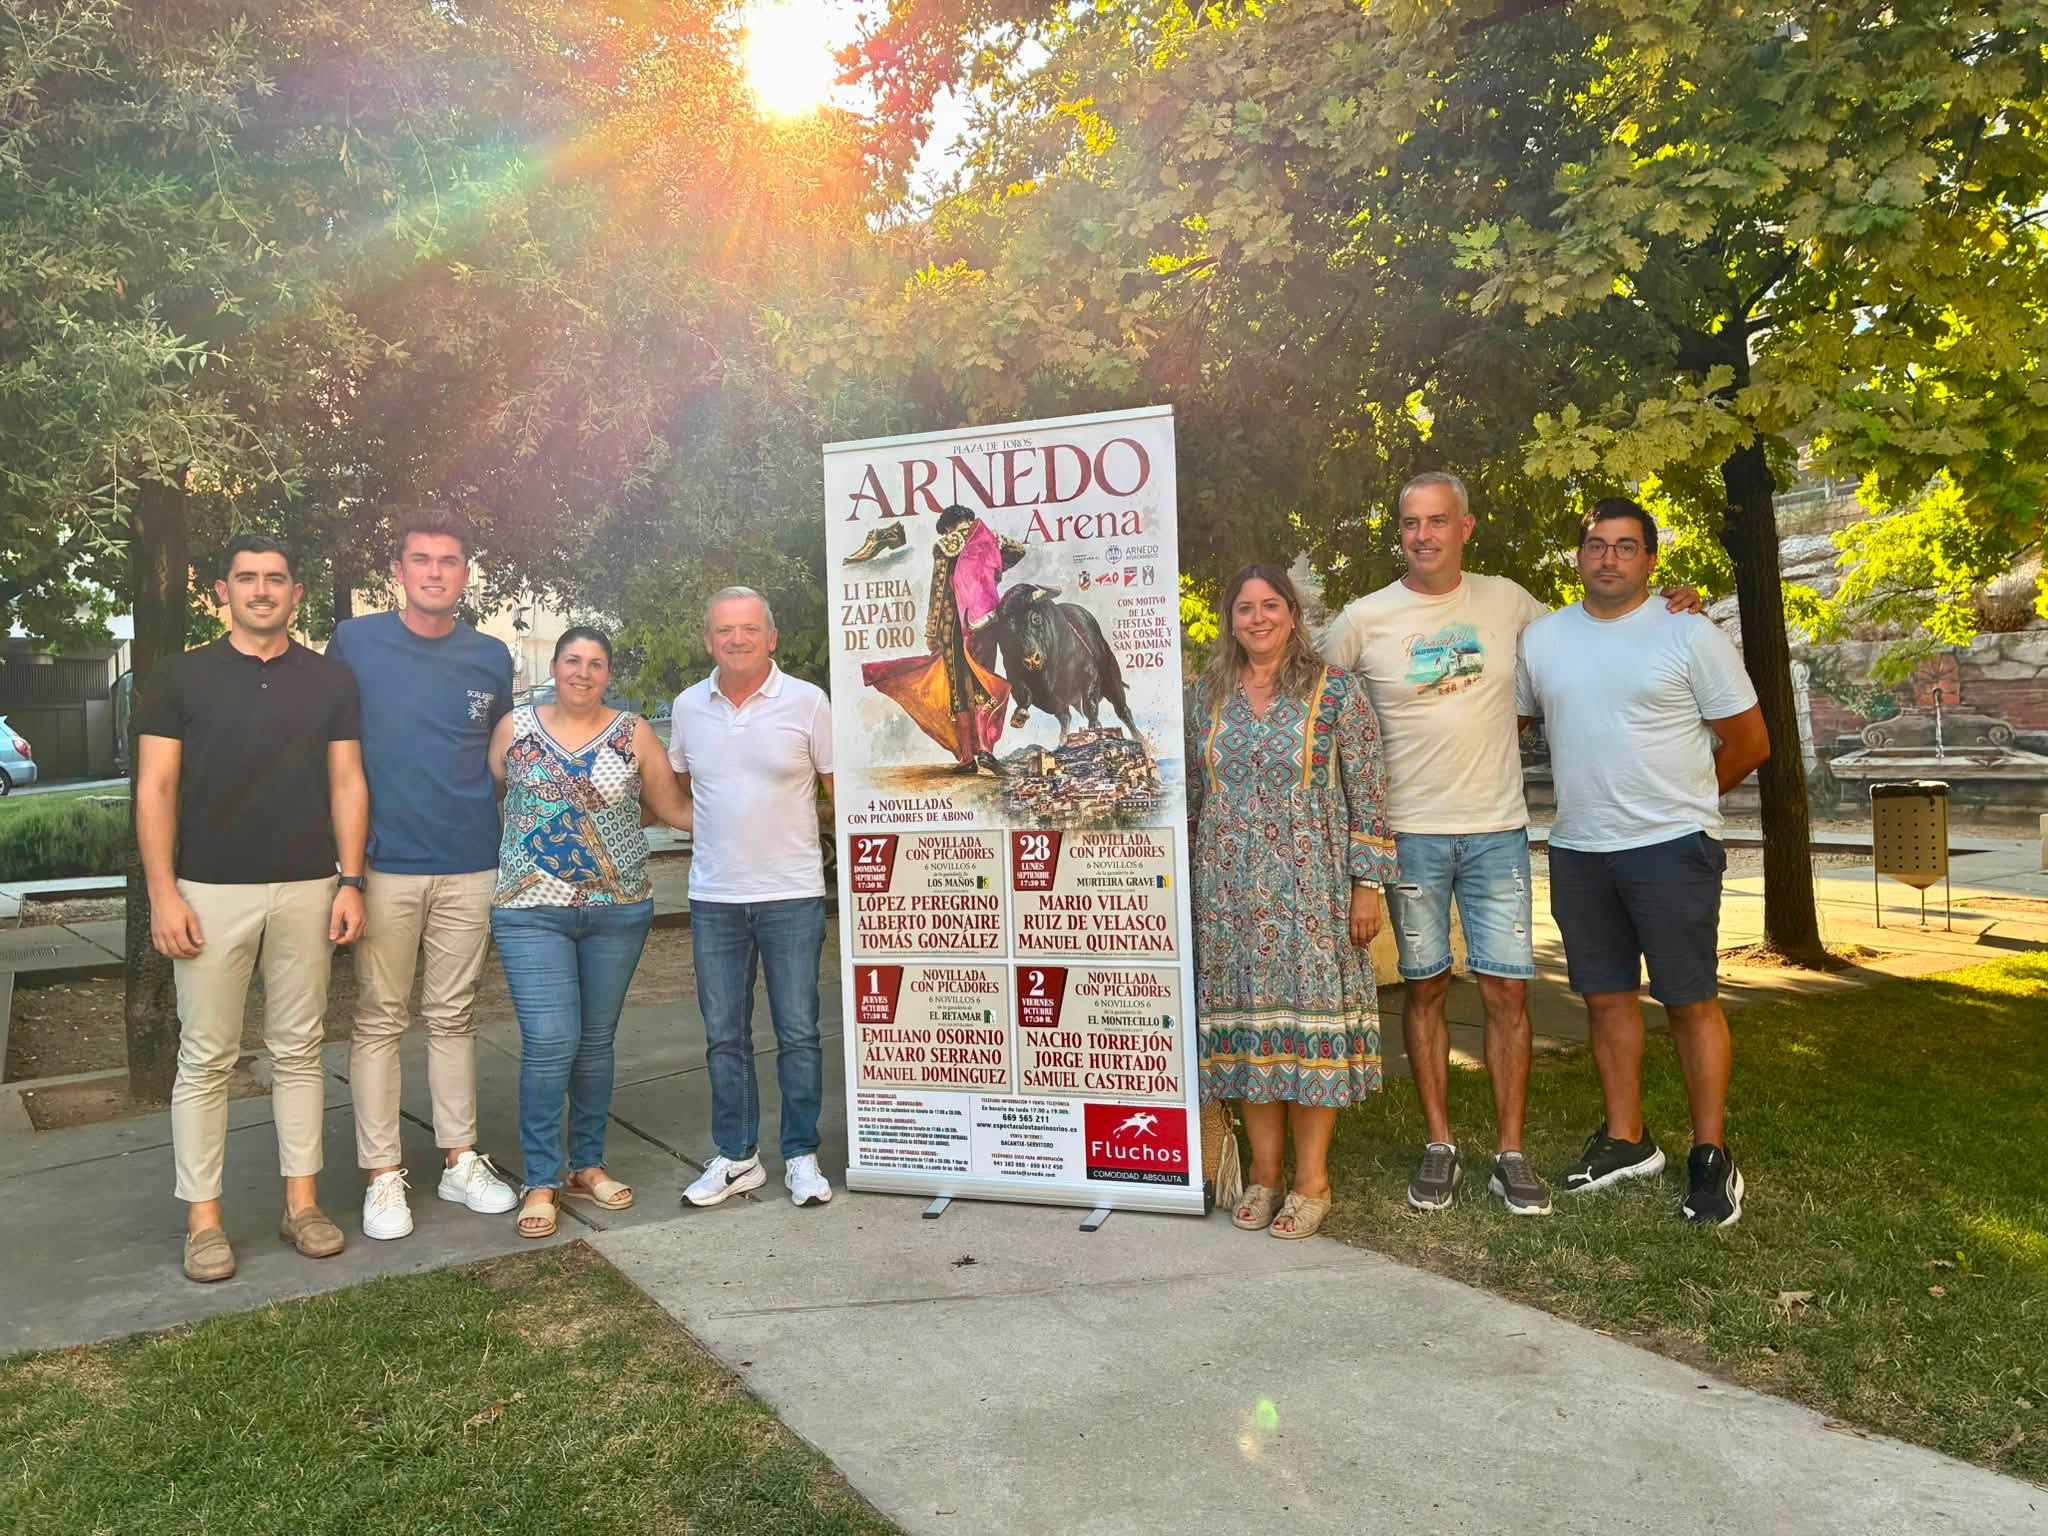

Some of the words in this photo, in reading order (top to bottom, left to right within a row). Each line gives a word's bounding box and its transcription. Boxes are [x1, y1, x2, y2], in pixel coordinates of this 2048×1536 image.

[954, 444, 984, 454] PLAZA
[986, 441, 997, 450] DE
[1003, 438, 1032, 449] TOROS
[845, 438, 1150, 521] ARNEDO
[1022, 509, 1143, 544] Arena
[1126, 545, 1159, 554] ARNEDO
[844, 584, 860, 600] LI
[866, 579, 912, 599] FERIA
[1118, 599, 1134, 608] CON
[1136, 596, 1166, 606] MOTIVO
[841, 600, 916, 626] ZAPATO
[1129, 608, 1138, 617] DE
[1141, 608, 1155, 616] LAS
[1118, 618, 1152, 628] FIESTAS
[1155, 617, 1166, 626] DE
[844, 630, 869, 650] DE
[876, 626, 914, 648] ORO
[1112, 630, 1130, 640] SAN
[1133, 628, 1164, 638] COSME
[1166, 627, 1172, 637] Y
[1114, 640, 1132, 651] SAN
[1126, 652, 1164, 668] 2026
[868, 800, 876, 812] 4
[879, 798, 953, 812] NOVILLADAS
[848, 814, 867, 824] CON
[870, 813, 923, 824] PICADORES
[926, 812, 940, 822] DE
[942, 811, 974, 822] ABONO
[918, 836, 982, 848] NOVILLADA
[1082, 834, 1151, 846] NOVILLADA
[858, 838, 888, 864] 27
[1020, 834, 1050, 860] 28
[1070, 846, 1094, 858] CON
[1099, 846, 1165, 858] PICADORES
[906, 849, 930, 860] CON
[934, 848, 994, 860] PICADORES
[930, 862, 970, 870] NOVILLOS
[1022, 862, 1044, 870] LUNES
[1093, 861, 1137, 869] NOVILLOS
[928, 878, 942, 888] LOS
[945, 876, 974, 887] MAÑOS
[1077, 878, 1123, 887] MURTEIRA
[1126, 877, 1154, 886] GRAVE
[858, 892, 906, 912] LÓPEZ
[911, 895, 999, 911] PEREGRINO
[1040, 894, 1092, 911] MARIO
[1098, 894, 1148, 911] VILAU
[858, 914, 926, 930] ALBERTO
[932, 914, 1000, 930] DONAIRE
[1024, 914, 1062, 930] RUIZ
[1068, 915, 1087, 930] DE
[1093, 914, 1166, 931] VELASCO
[860, 930, 912, 949] TOMÁS
[918, 930, 998, 949] GONZÁLEZ
[1086, 934, 1174, 952] QUINTANA
[868, 969, 880, 994] 1
[923, 970, 986, 981] NOVILLADA
[1088, 972, 1156, 984] NOVILLADA
[910, 982, 934, 992] CON
[939, 982, 999, 994] PICADORES
[1029, 970, 1044, 996] 2
[1076, 984, 1100, 996] CON
[1104, 984, 1171, 998] PICADORES
[862, 996, 888, 1004] JUEVES
[935, 995, 974, 1003] NOVILLOS
[1022, 998, 1054, 1006] VIERNES
[1101, 1000, 1145, 1008] NOVILLOS
[862, 1004, 889, 1012] OCTUBRE
[1024, 1007, 1053, 1015] OCTUBRE
[930, 1011, 940, 1020] EL
[942, 1011, 981, 1020] RETAMAR
[1088, 1016, 1099, 1024] EL
[1102, 1016, 1160, 1026] MONTECILLO
[936, 1028, 1004, 1046] OSORNIO
[1026, 1032, 1082, 1048] NACHO
[1087, 1031, 1172, 1053] TORREJÓN
[866, 1043, 926, 1062] ÁLVARO
[931, 1047, 1002, 1065] SERRANO
[1034, 1051, 1084, 1068] JORGE
[1090, 1053, 1166, 1072] HURTADO
[922, 1064, 1006, 1084] DOMÍNGUEZ
[1024, 1070, 1079, 1088] SAMUEL
[1084, 1072, 1178, 1094] CASTREJÓN
[1036, 1115, 1048, 1123] 211
[1092, 1140, 1182, 1162] Fluchos
[1093, 1170, 1140, 1180] COMODIDAD
[1142, 1174, 1182, 1183] ABSOLUTA
